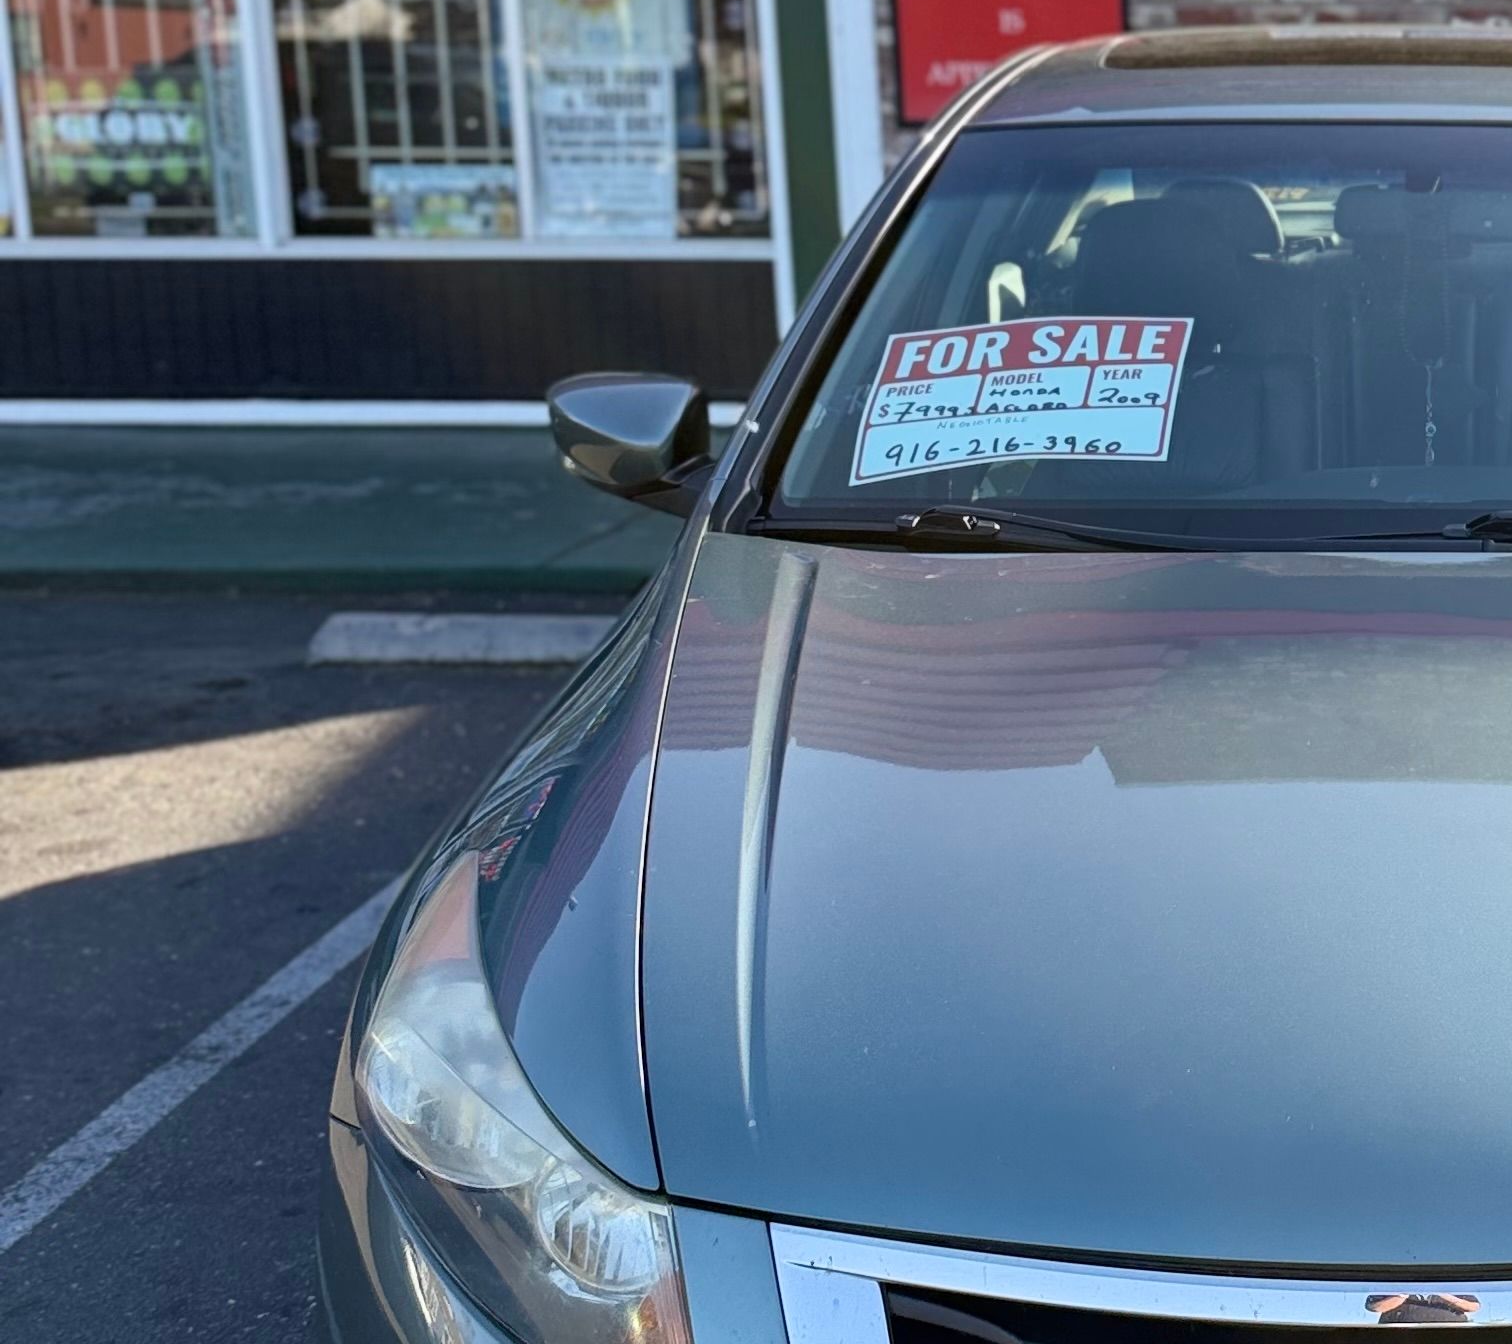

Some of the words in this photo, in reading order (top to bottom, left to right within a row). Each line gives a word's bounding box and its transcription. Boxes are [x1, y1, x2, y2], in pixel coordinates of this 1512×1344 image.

[998, 9, 1026, 35] IS
[895, 331, 1011, 379] FOR
[1028, 325, 1172, 365] SALE
[991, 372, 1044, 387] MODEL
[1102, 369, 1143, 381] YEAR
[886, 383, 934, 397] PRICE
[1098, 388, 1160, 406] 2009
[885, 436, 1122, 467] 916-216-3960
